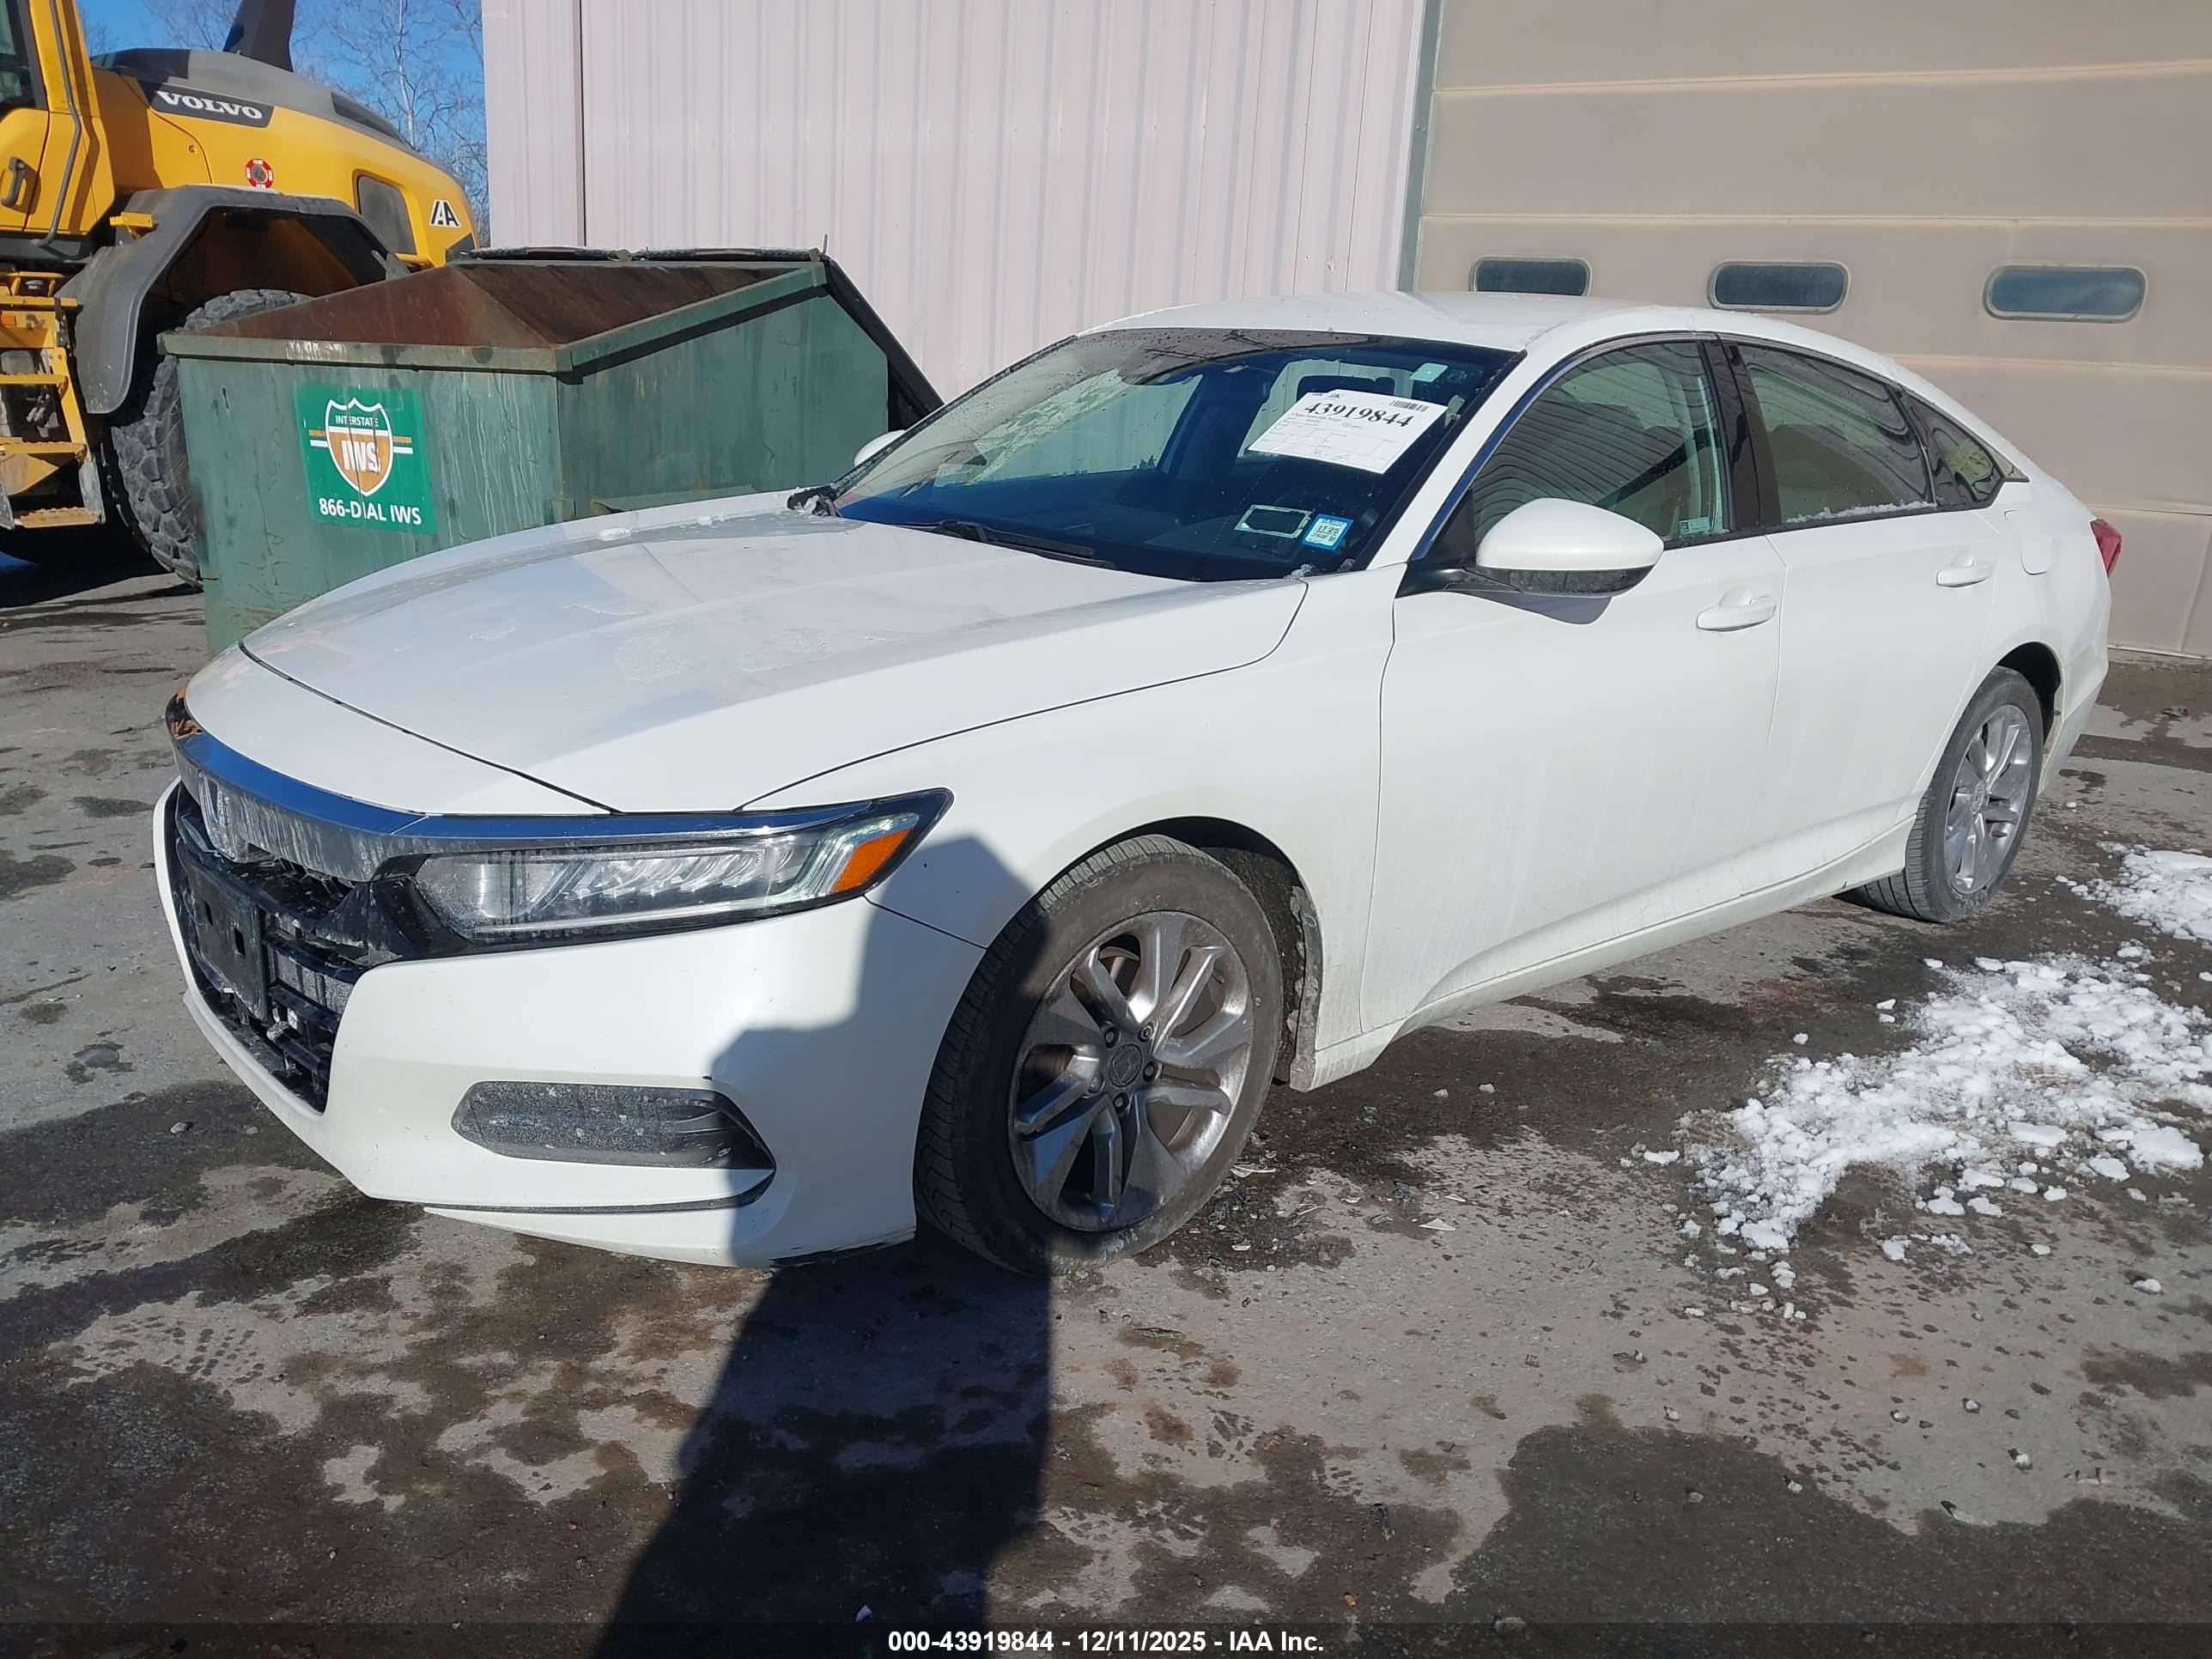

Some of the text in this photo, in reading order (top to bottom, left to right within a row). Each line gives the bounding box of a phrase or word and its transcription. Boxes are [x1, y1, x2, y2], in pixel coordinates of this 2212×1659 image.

[156, 90, 263, 120] VOLVO
[335, 415, 380, 428] INTERSTATE
[1304, 401, 1415, 428] 43919844
[319, 497, 422, 526] 866-DIAL IWS
